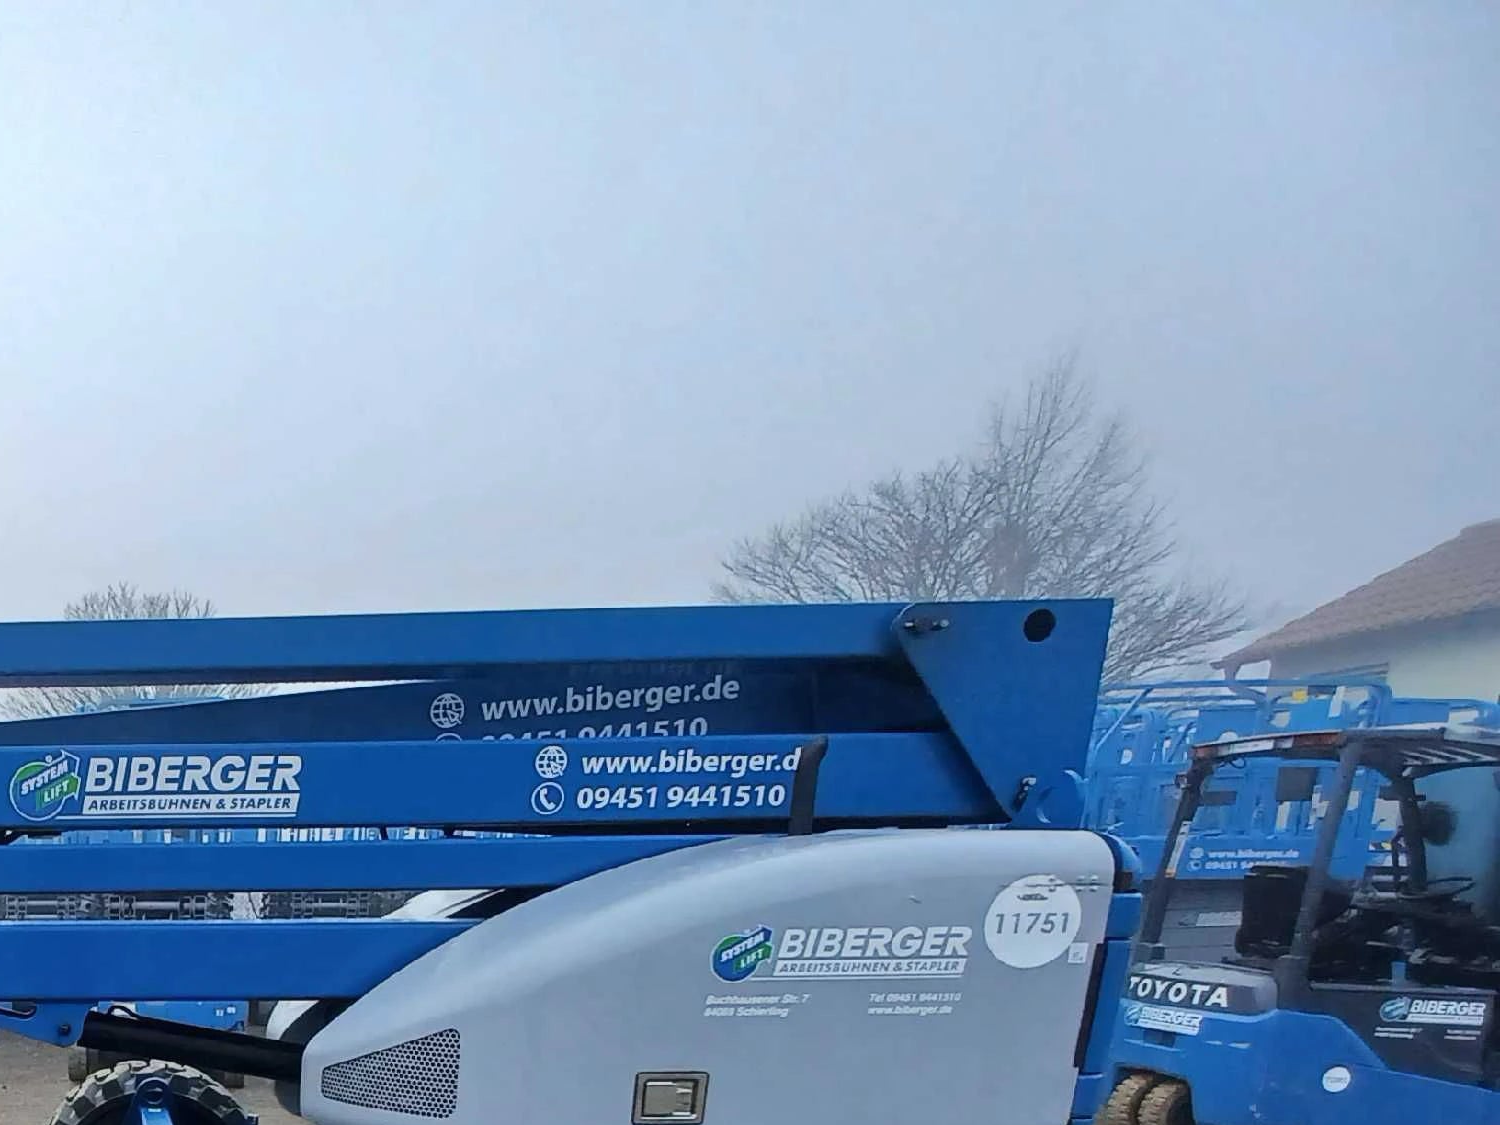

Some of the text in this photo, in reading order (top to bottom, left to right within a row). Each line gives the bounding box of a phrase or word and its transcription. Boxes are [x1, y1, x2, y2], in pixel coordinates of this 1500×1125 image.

[481, 674, 740, 721] www.biberger.de
[85, 755, 301, 793] BIBERGER
[582, 747, 802, 778] www.biberger.d
[21, 760, 68, 795] SYSTEM
[44, 779, 69, 802] LIFT
[577, 784, 785, 809] 09451 9441510
[215, 799, 227, 810] &
[230, 797, 291, 809] STAPLER
[995, 912, 1069, 934] 11751
[778, 926, 972, 959] BIBERGER
[740, 949, 764, 968] LIFT
[905, 960, 959, 972] STAPLER
[1129, 976, 1228, 1008] TOYOTA
[1409, 999, 1486, 1016] BIBERGER
